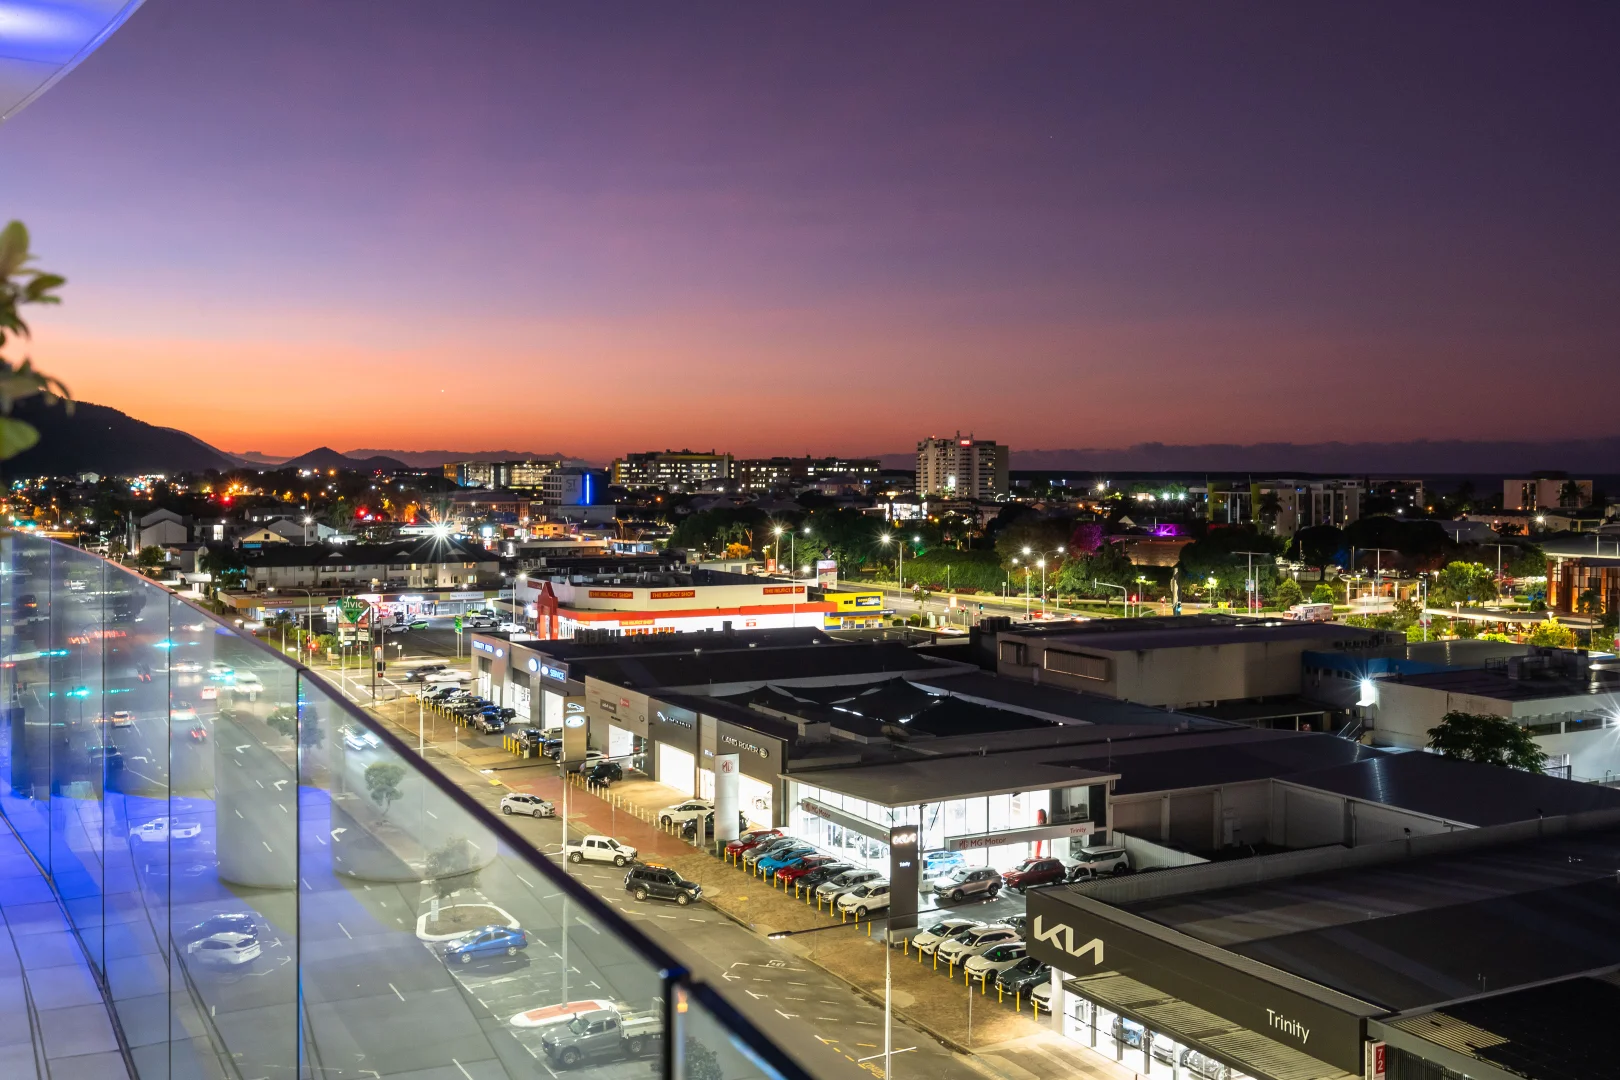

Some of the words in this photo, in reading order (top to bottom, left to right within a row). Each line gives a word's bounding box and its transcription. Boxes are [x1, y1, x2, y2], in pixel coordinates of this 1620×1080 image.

[721, 735, 738, 746] LAND
[738, 740, 759, 755] ROVER
[722, 760, 733, 773] MG
[970, 839, 983, 847] MG
[984, 836, 1007, 845] Motor
[1069, 826, 1087, 834] Trinity
[1034, 914, 1104, 966] KIA
[1266, 1008, 1310, 1044] Trinity
